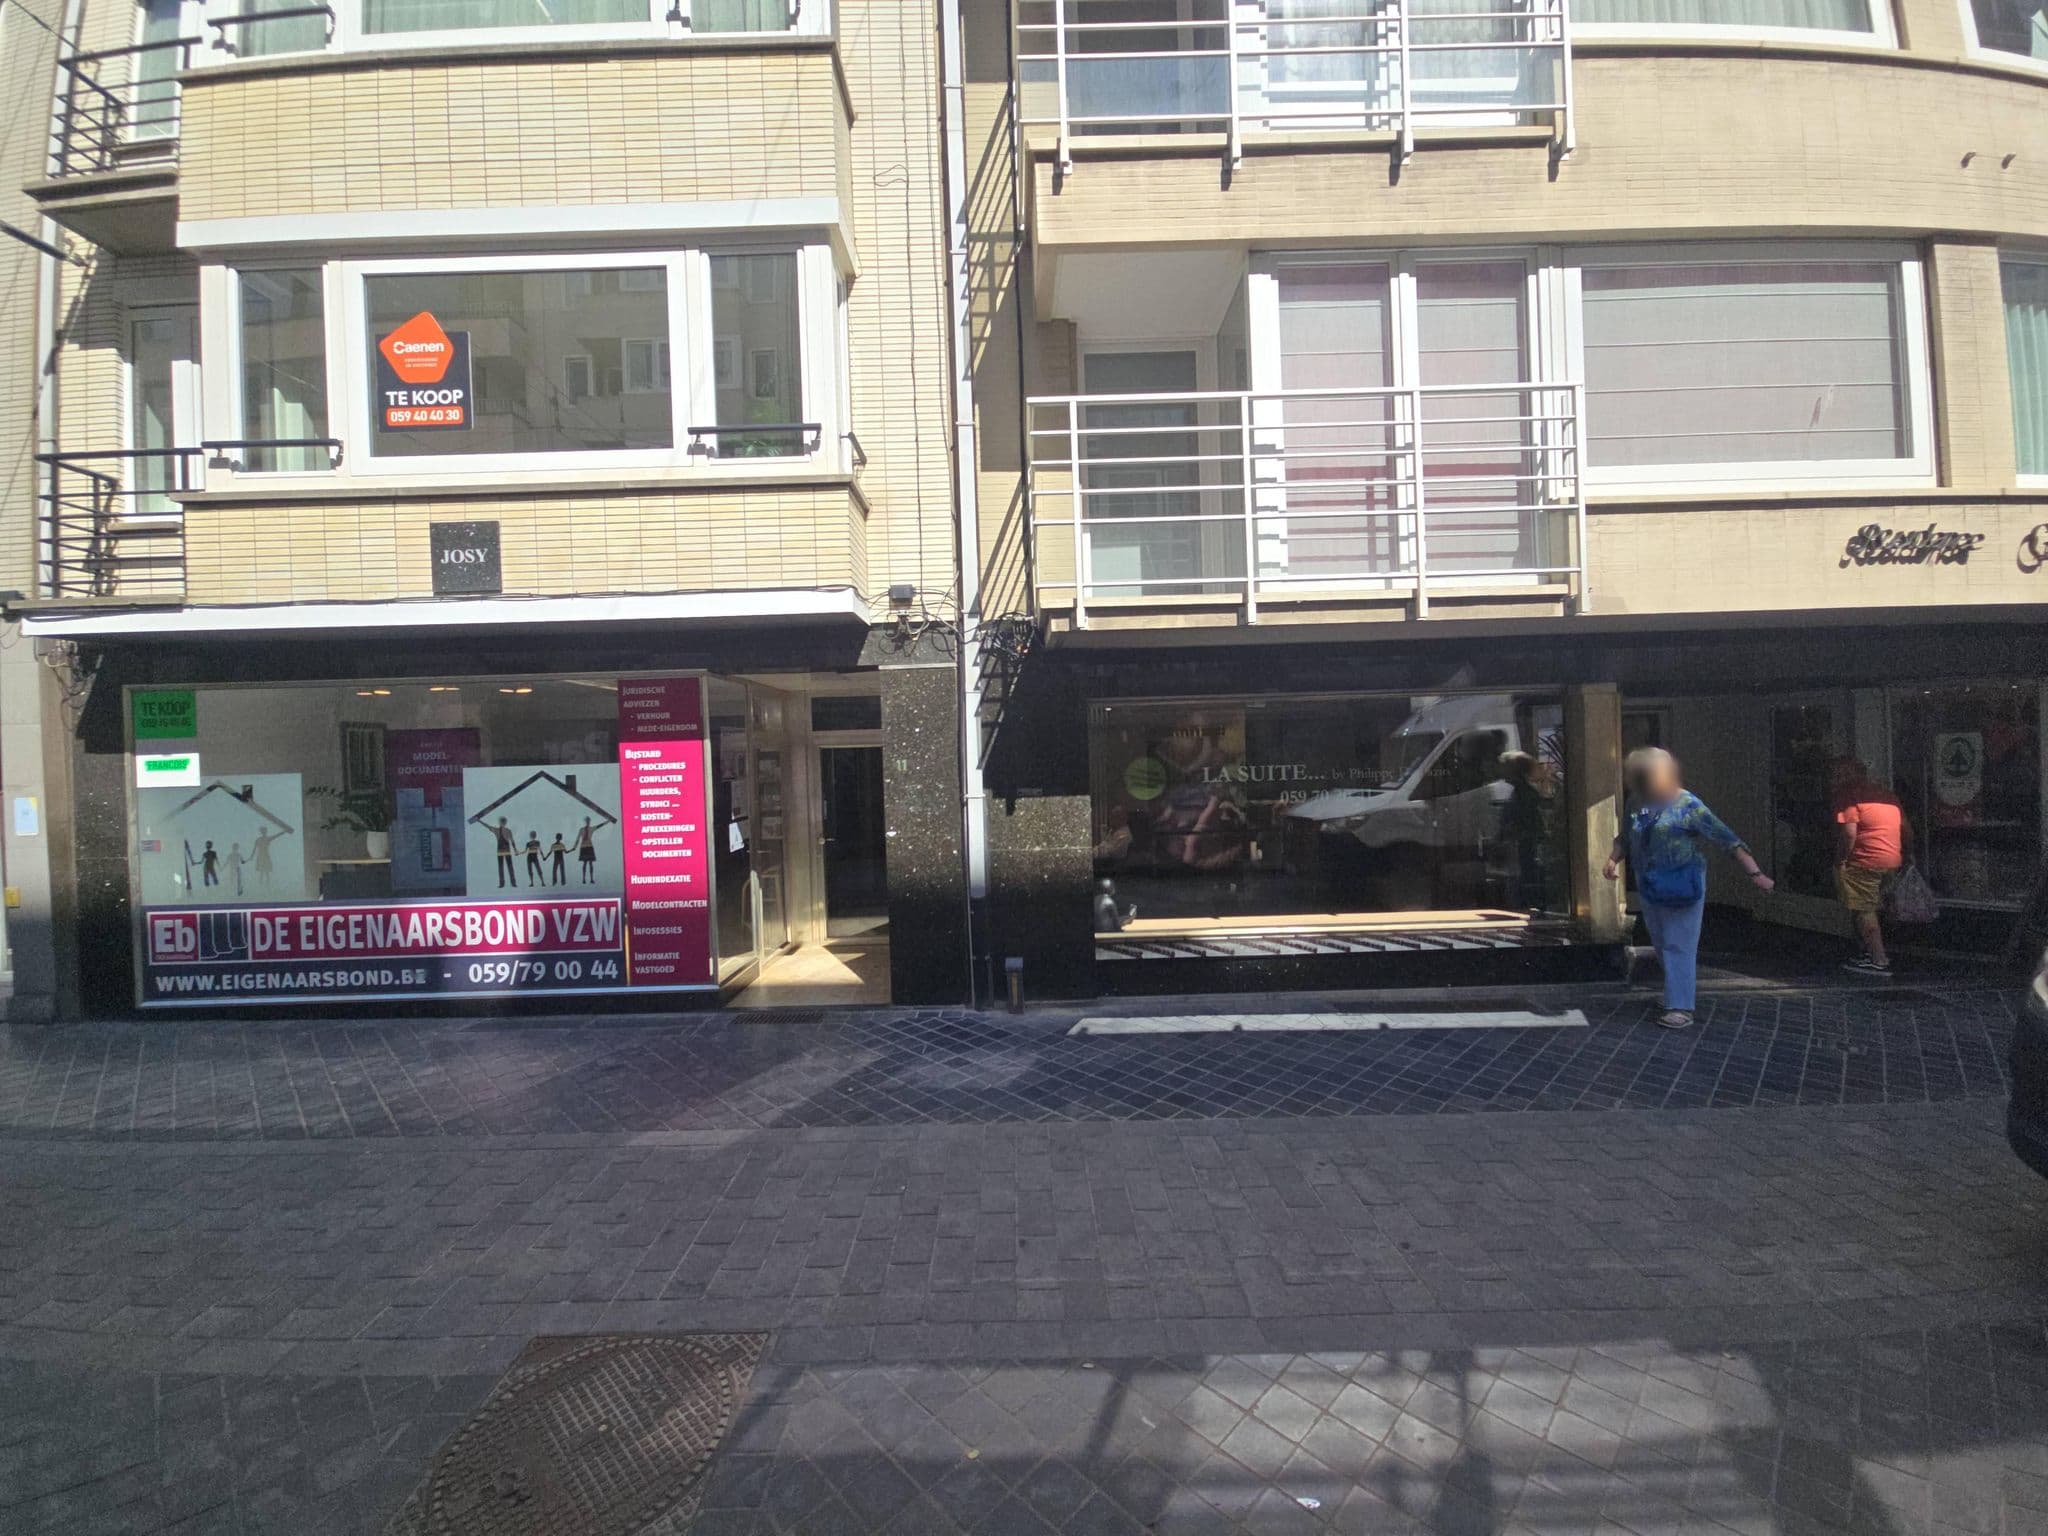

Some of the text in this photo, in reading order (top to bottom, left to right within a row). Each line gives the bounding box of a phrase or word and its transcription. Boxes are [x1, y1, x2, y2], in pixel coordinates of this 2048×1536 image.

[393, 341, 445, 354] Caenen
[385, 389, 464, 406] TE KOOP
[390, 409, 460, 422] 059 40 40 30
[440, 548, 488, 564] JOSY
[622, 686, 666, 696] JURIDISCHE
[623, 700, 660, 708] ADVIEZEN
[639, 762, 686, 771] PROCEDURES
[1203, 766, 1233, 783] LA
[1237, 764, 1325, 782] SUITE...
[639, 775, 683, 783] CONFLICTEN
[1280, 790, 1306, 803] 059
[640, 800, 670, 808] SYNDICI
[641, 824, 695, 833] AFREKENINGEN
[642, 837, 683, 845] OPSTELLEN
[643, 849, 692, 858] DOCUMENTEN
[631, 875, 691, 884] HUURINDEXATIE
[632, 900, 707, 910] MODELCONTRACTEN
[154, 906, 616, 952] Eb DE EIGENAARSBOND VZW
[633, 926, 683, 935] INFOSESSIES
[635, 952, 680, 960] INFORMATIE
[635, 965, 675, 973] VASTGOED
[156, 969, 426, 992] WWW.EIGENAARSBOND.BE
[468, 960, 546, 985] 059/79
[554, 961, 582, 980] 00
[590, 959, 618, 980] 44
